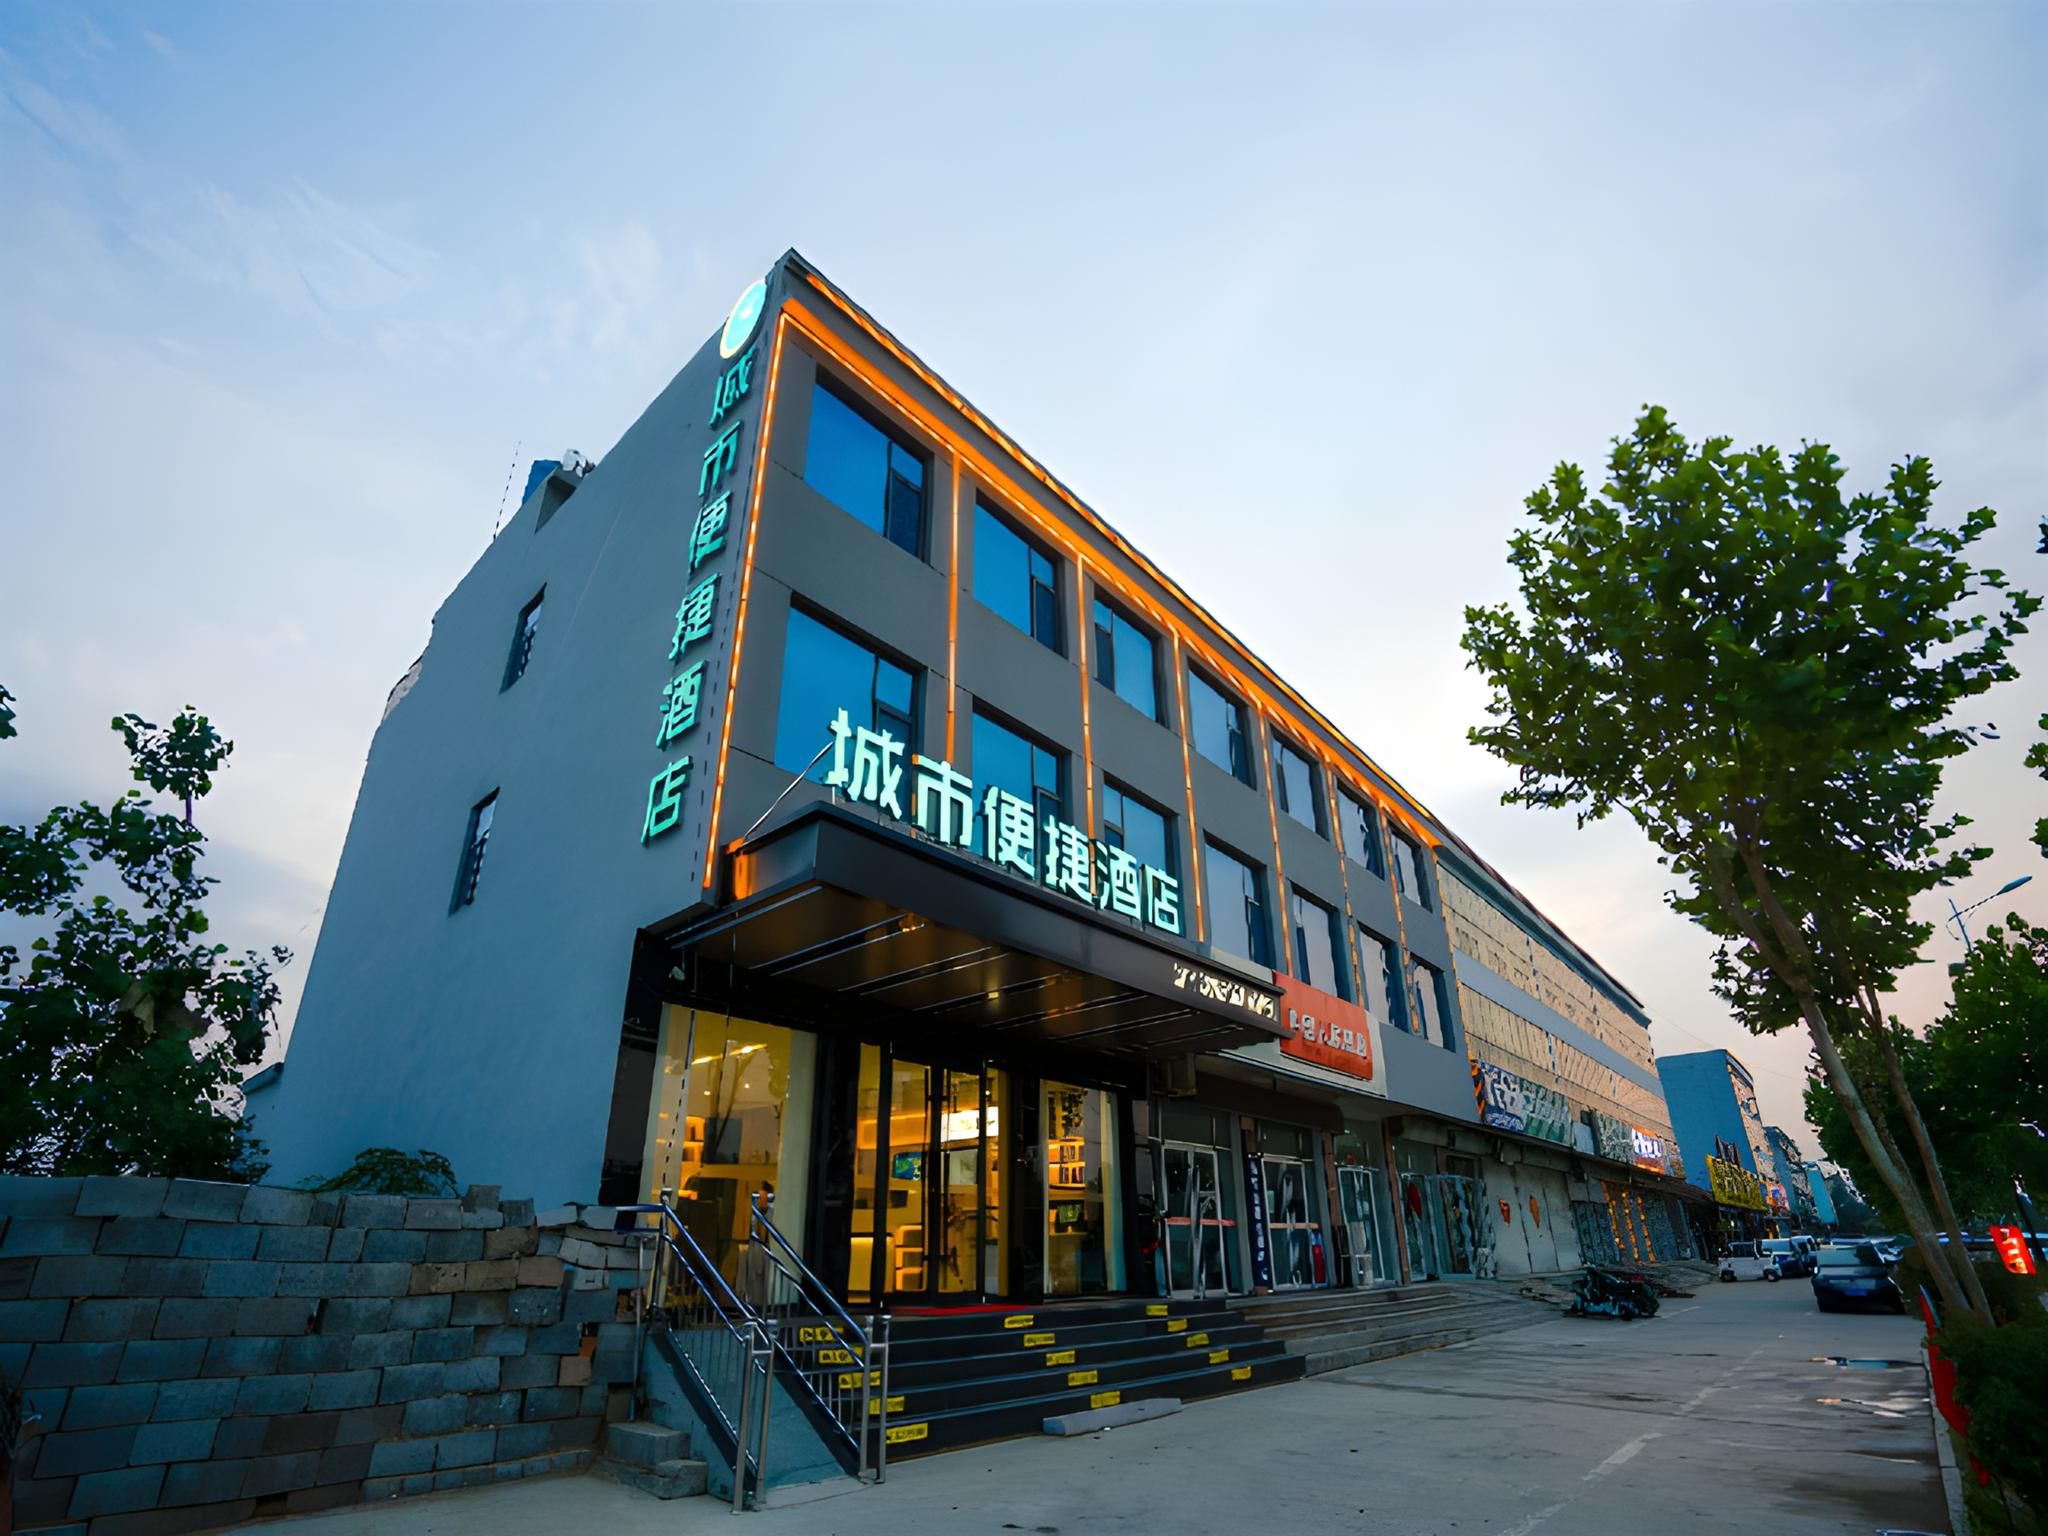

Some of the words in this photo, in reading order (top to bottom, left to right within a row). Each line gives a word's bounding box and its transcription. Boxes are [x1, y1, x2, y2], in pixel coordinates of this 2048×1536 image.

[640, 344, 757, 844] 城市便捷酒店
[823, 707, 1181, 936] 城市便捷酒店
